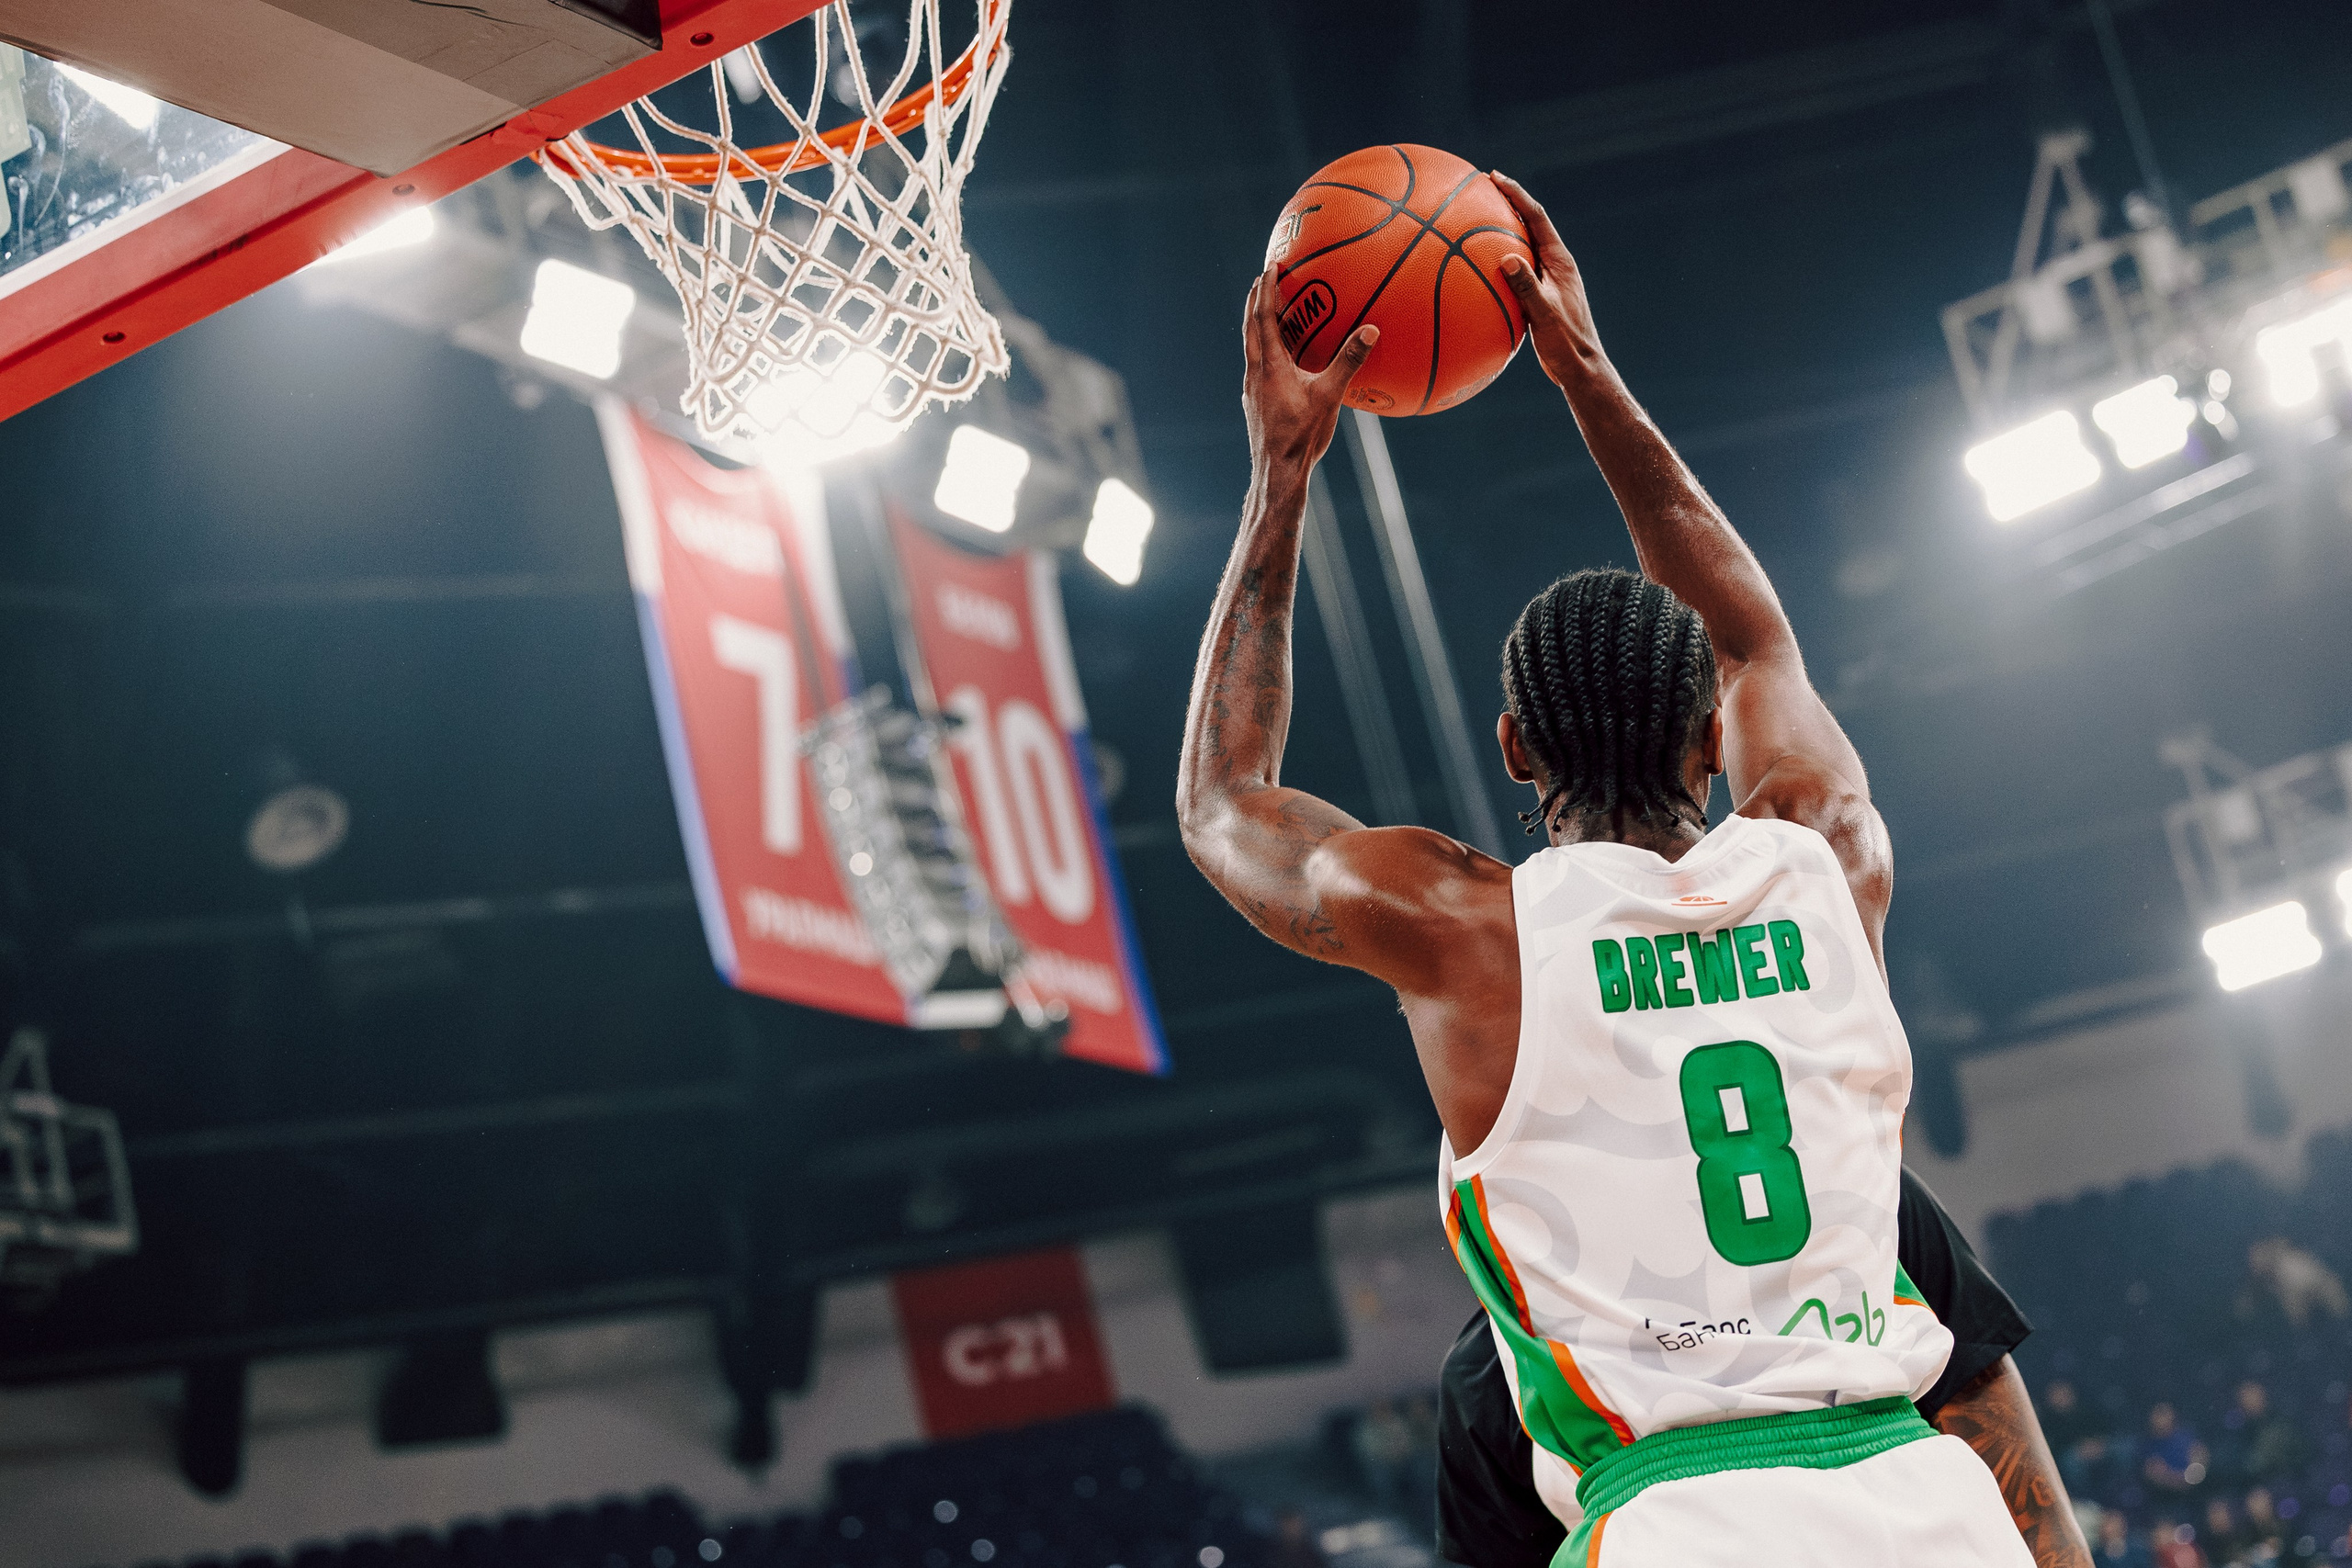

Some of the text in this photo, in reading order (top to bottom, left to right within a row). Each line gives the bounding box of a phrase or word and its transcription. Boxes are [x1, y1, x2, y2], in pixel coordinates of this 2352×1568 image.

[710, 613, 803, 856] 7
[946, 685, 1094, 923] 10
[1592, 919, 1810, 1013] BREWER
[1679, 1040, 1811, 1267] 8
